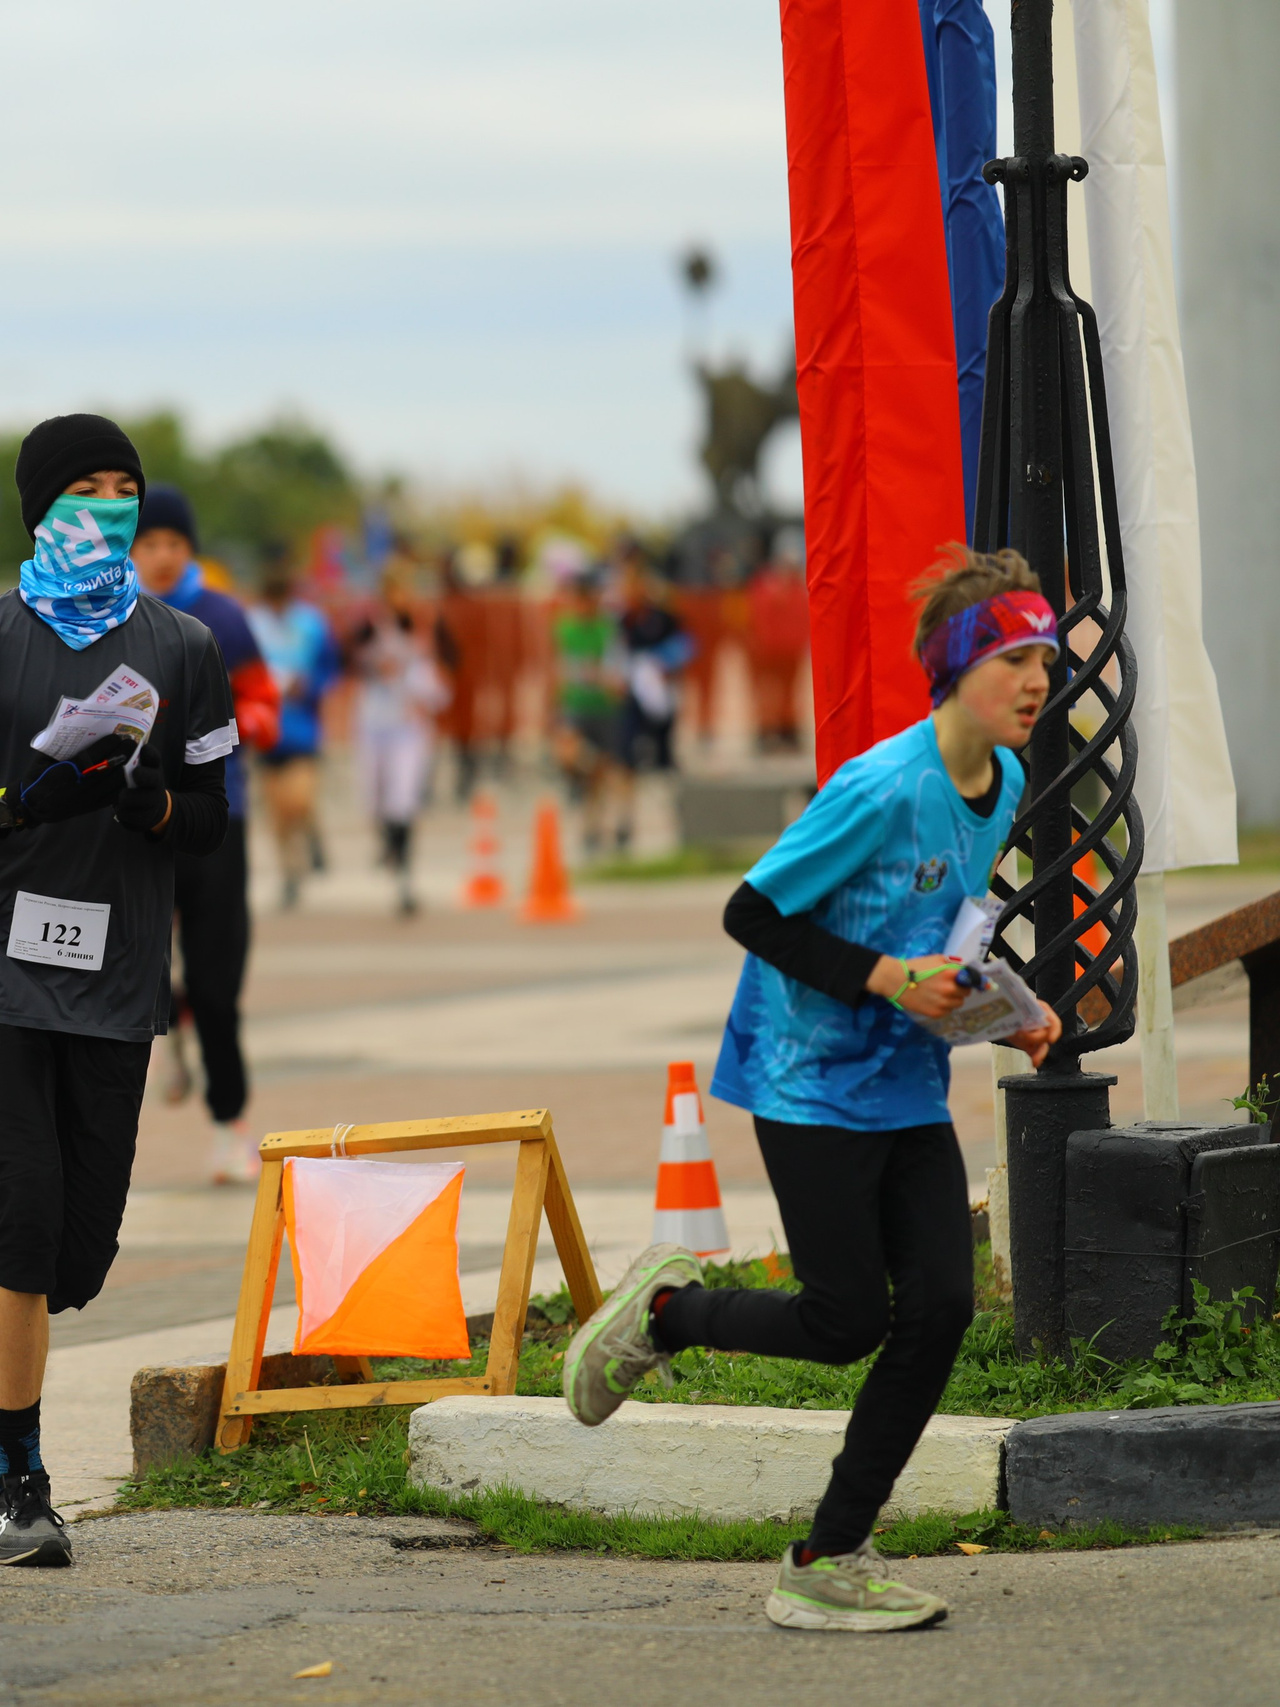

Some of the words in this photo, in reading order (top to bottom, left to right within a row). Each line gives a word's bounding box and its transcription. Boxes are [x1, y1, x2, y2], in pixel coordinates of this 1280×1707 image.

[40, 922, 82, 947] 122
[57, 949, 63, 957] 6
[64, 951, 94, 961] линия
